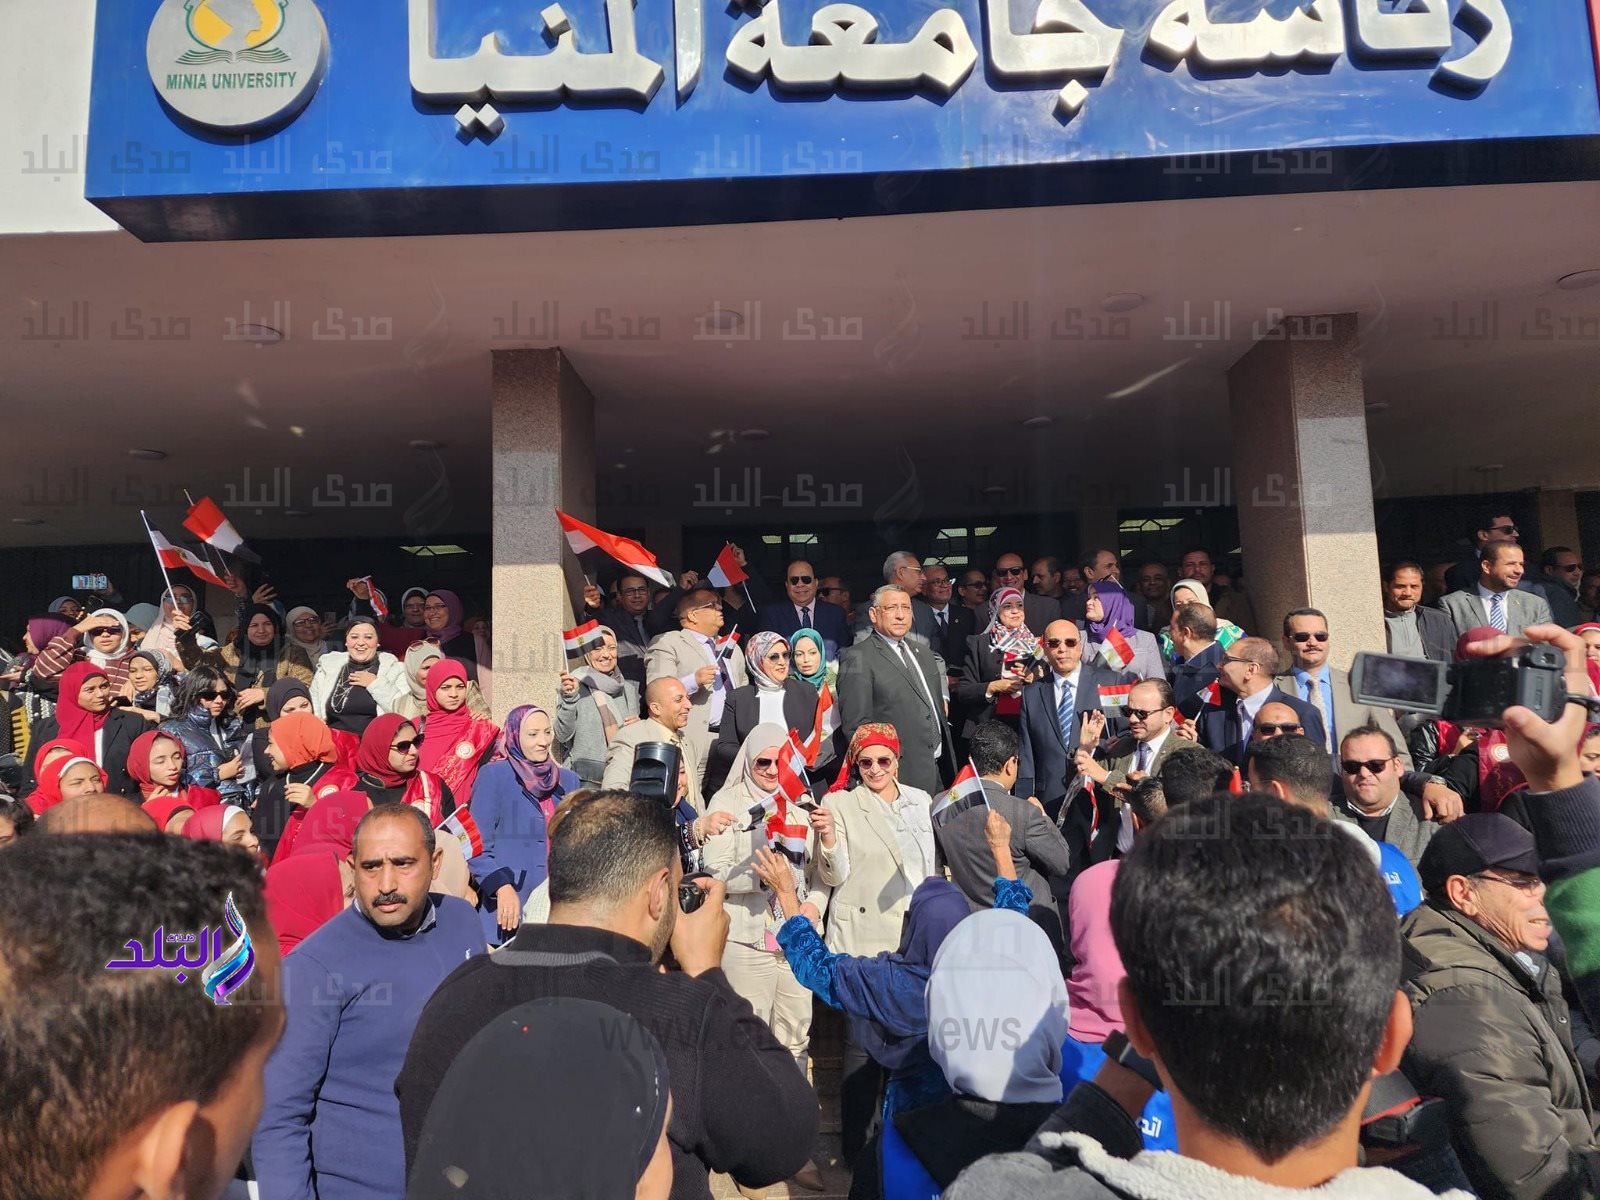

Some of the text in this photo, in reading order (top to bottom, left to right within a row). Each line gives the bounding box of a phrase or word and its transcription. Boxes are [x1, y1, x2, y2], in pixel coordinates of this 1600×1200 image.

[166, 71, 297, 90] MINIA UNIVERSITY
[408, 0, 701, 134] المنيا
[725, 0, 1125, 112] جامعة
